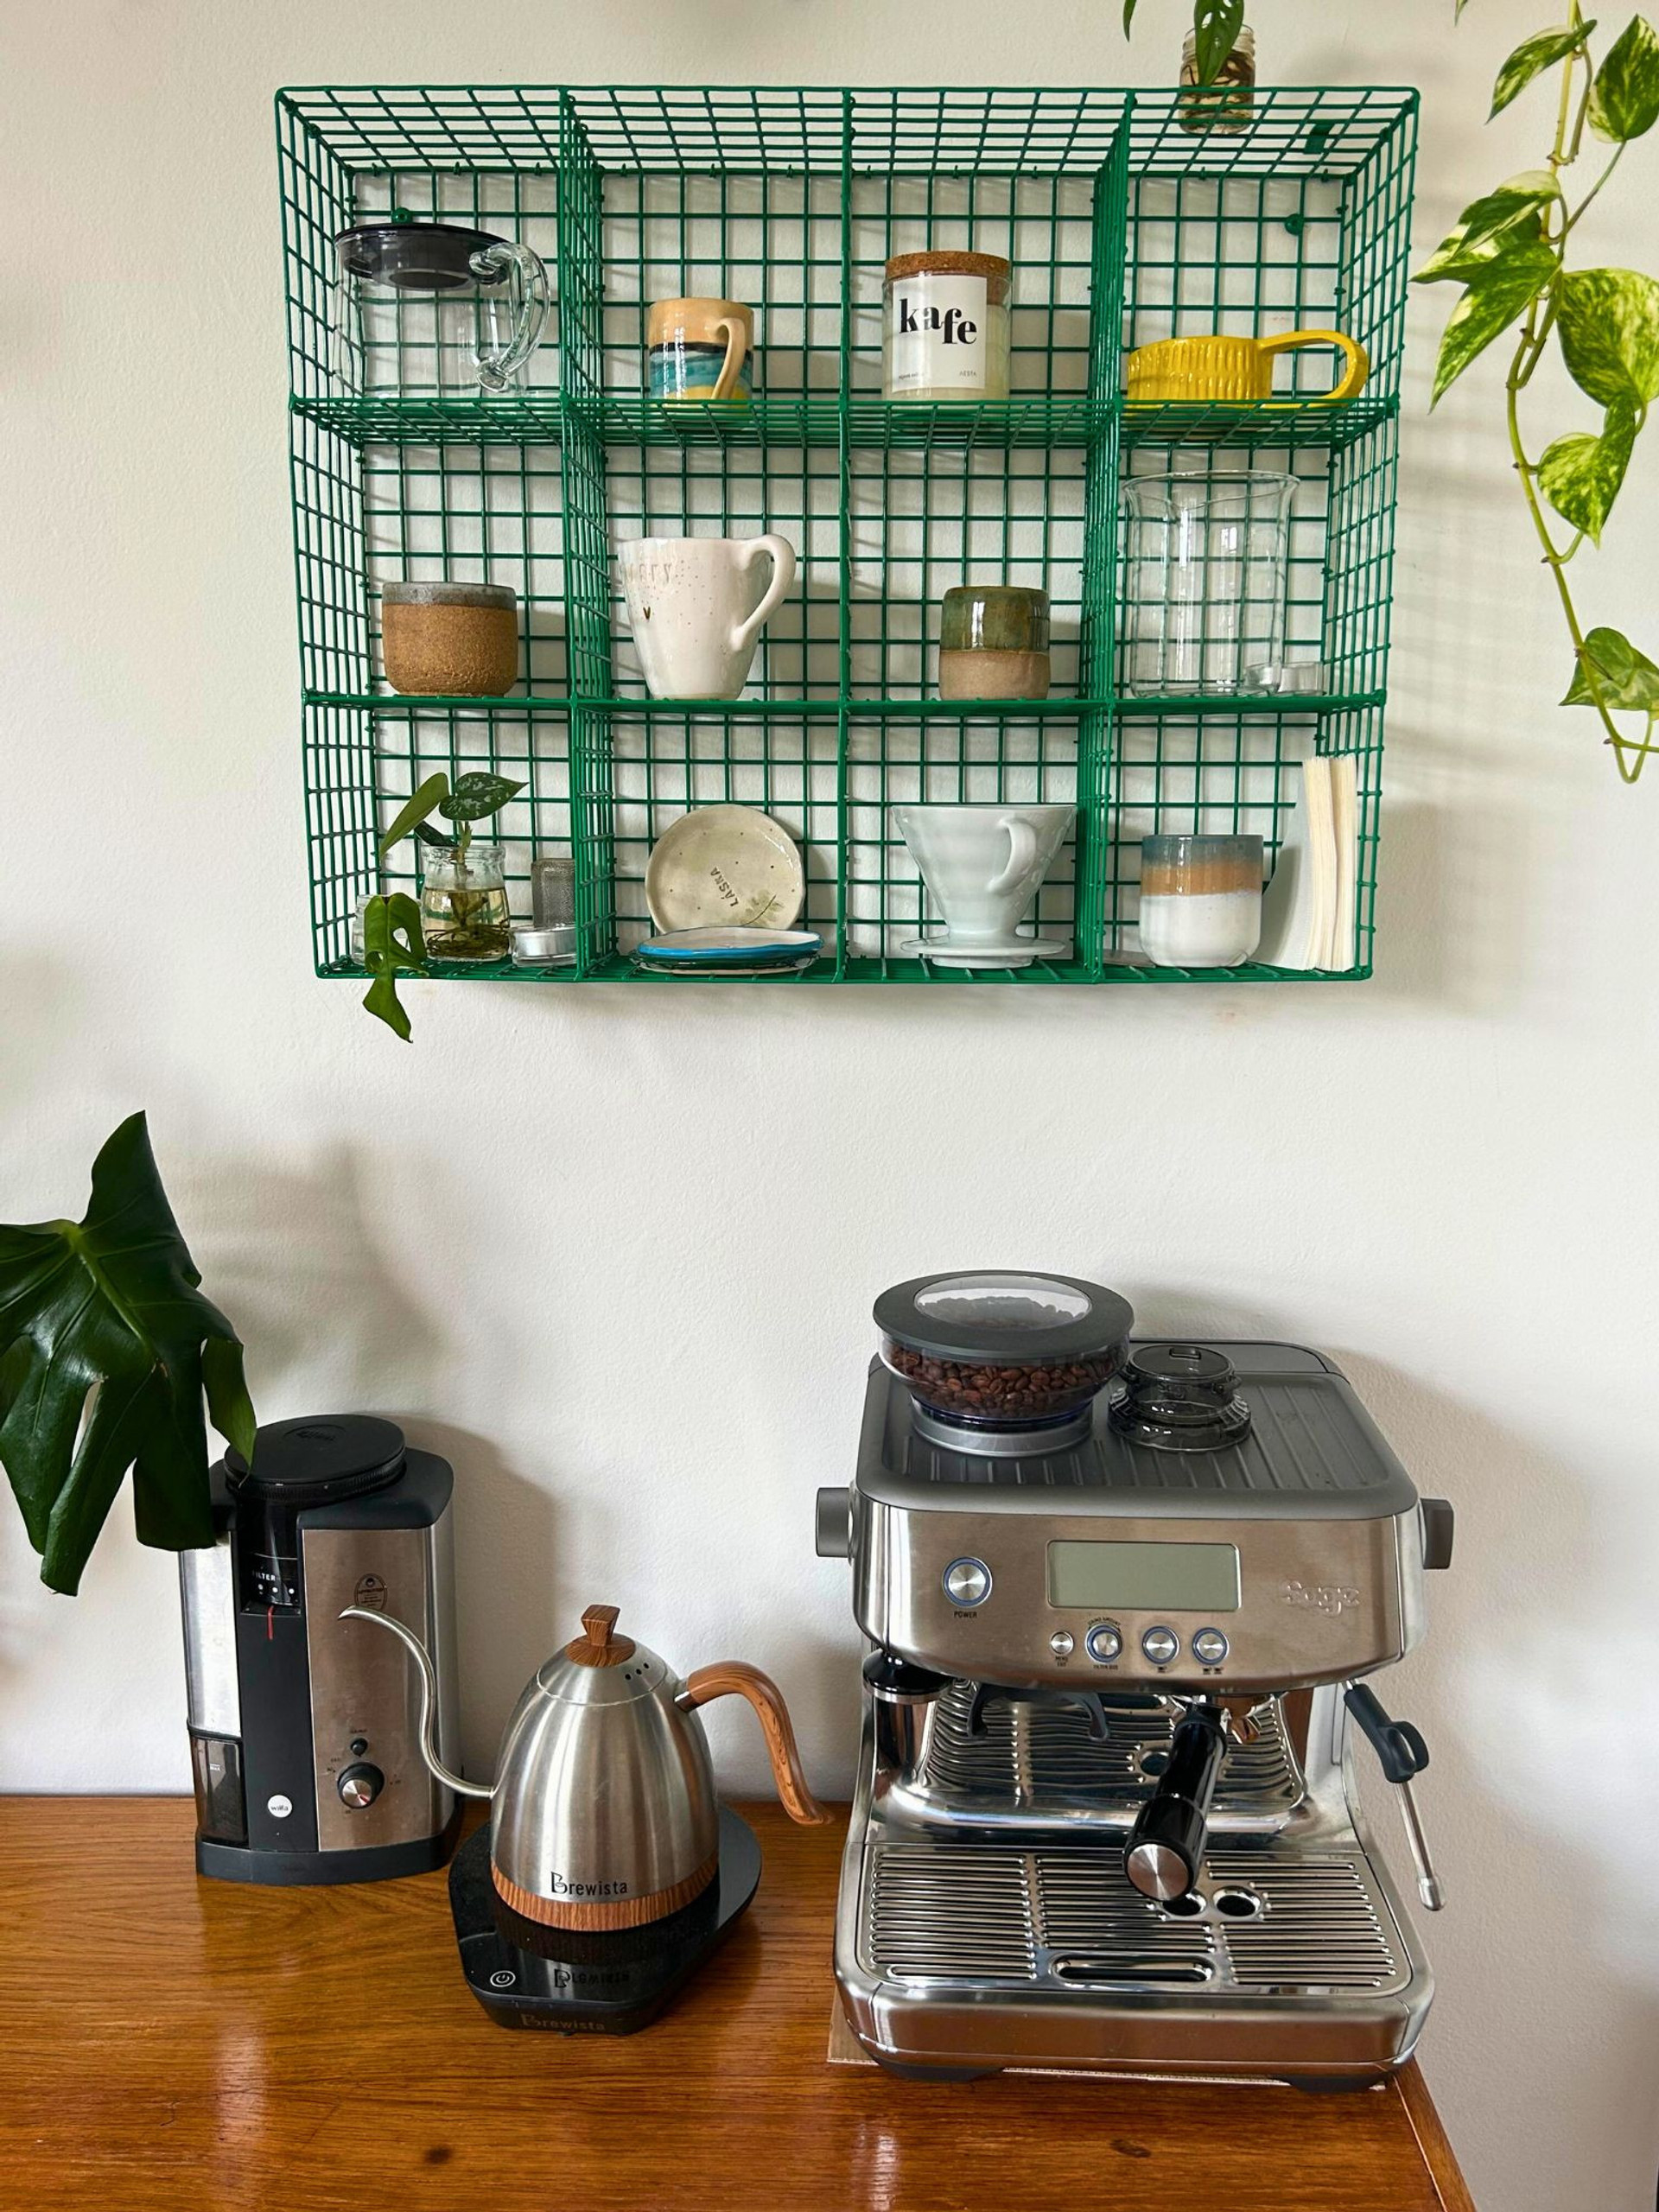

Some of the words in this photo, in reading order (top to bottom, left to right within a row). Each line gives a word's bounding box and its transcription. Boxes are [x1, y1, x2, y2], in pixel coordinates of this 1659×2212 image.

[899, 298, 977, 345] kafe
[251, 1570, 276, 1580] ILTER
[550, 1871, 628, 1896] Brewista
